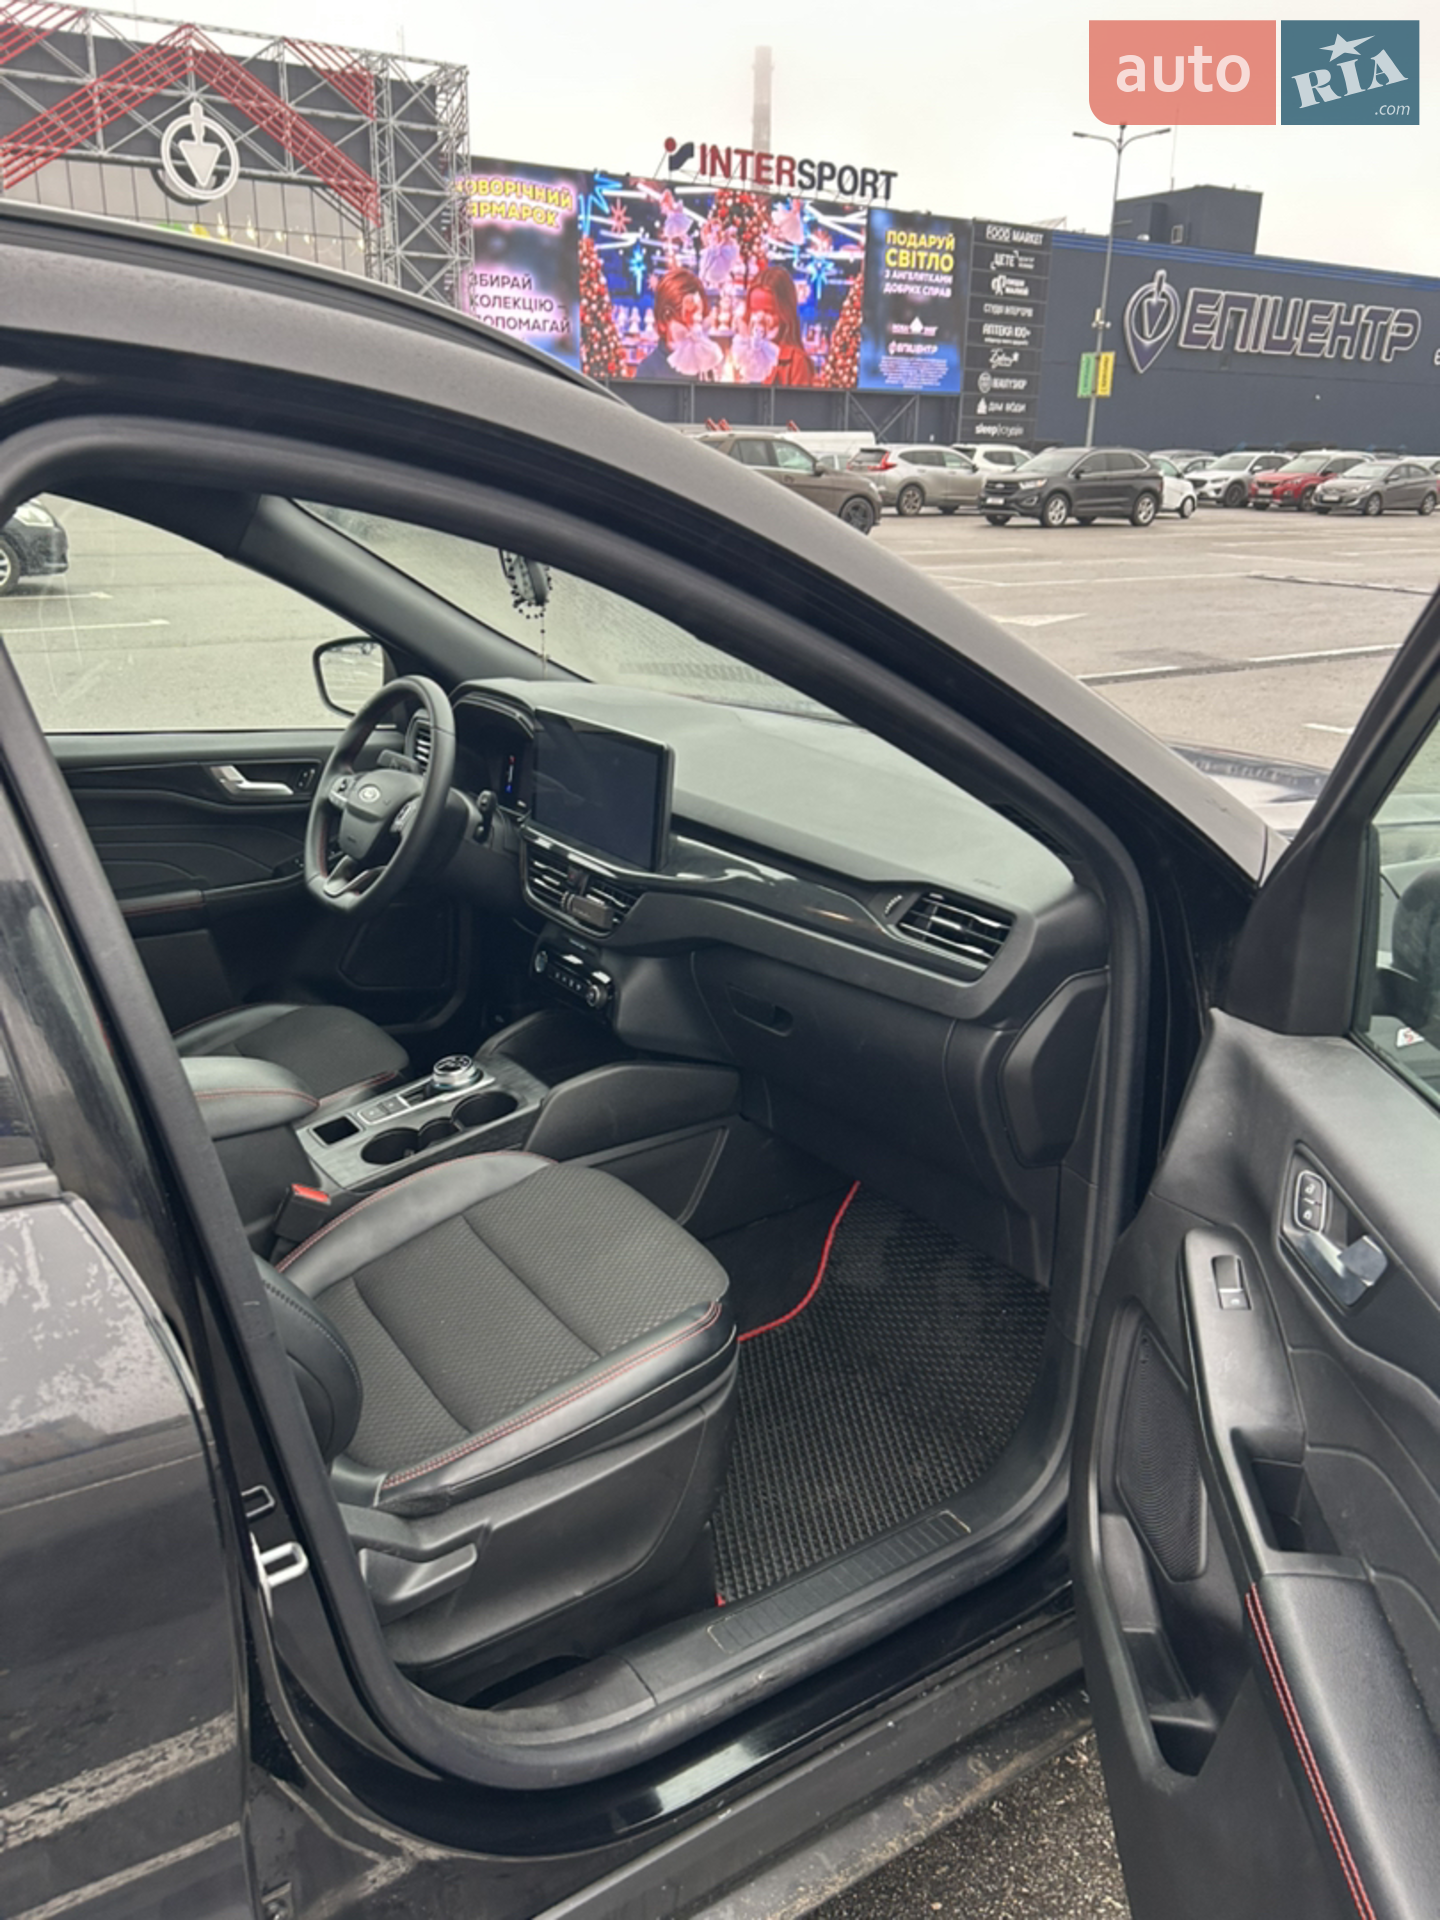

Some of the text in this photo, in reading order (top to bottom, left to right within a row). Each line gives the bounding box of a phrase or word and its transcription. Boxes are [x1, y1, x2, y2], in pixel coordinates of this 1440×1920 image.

[700, 142, 898, 200] INTERSPORT
[886, 230, 955, 251] ПОДАРУЙ
[1012, 230, 1043, 246] MARKET
[885, 247, 954, 272] СВІТЛО
[469, 272, 532, 290] ЗБИРАЙ
[922, 285, 952, 298] СПРАВ
[470, 294, 554, 314] КОЛЕКЦІЮ
[475, 314, 571, 333] ОПОМАГАЙ
[1178, 287, 1421, 363] ЕПІЦЕНТР
